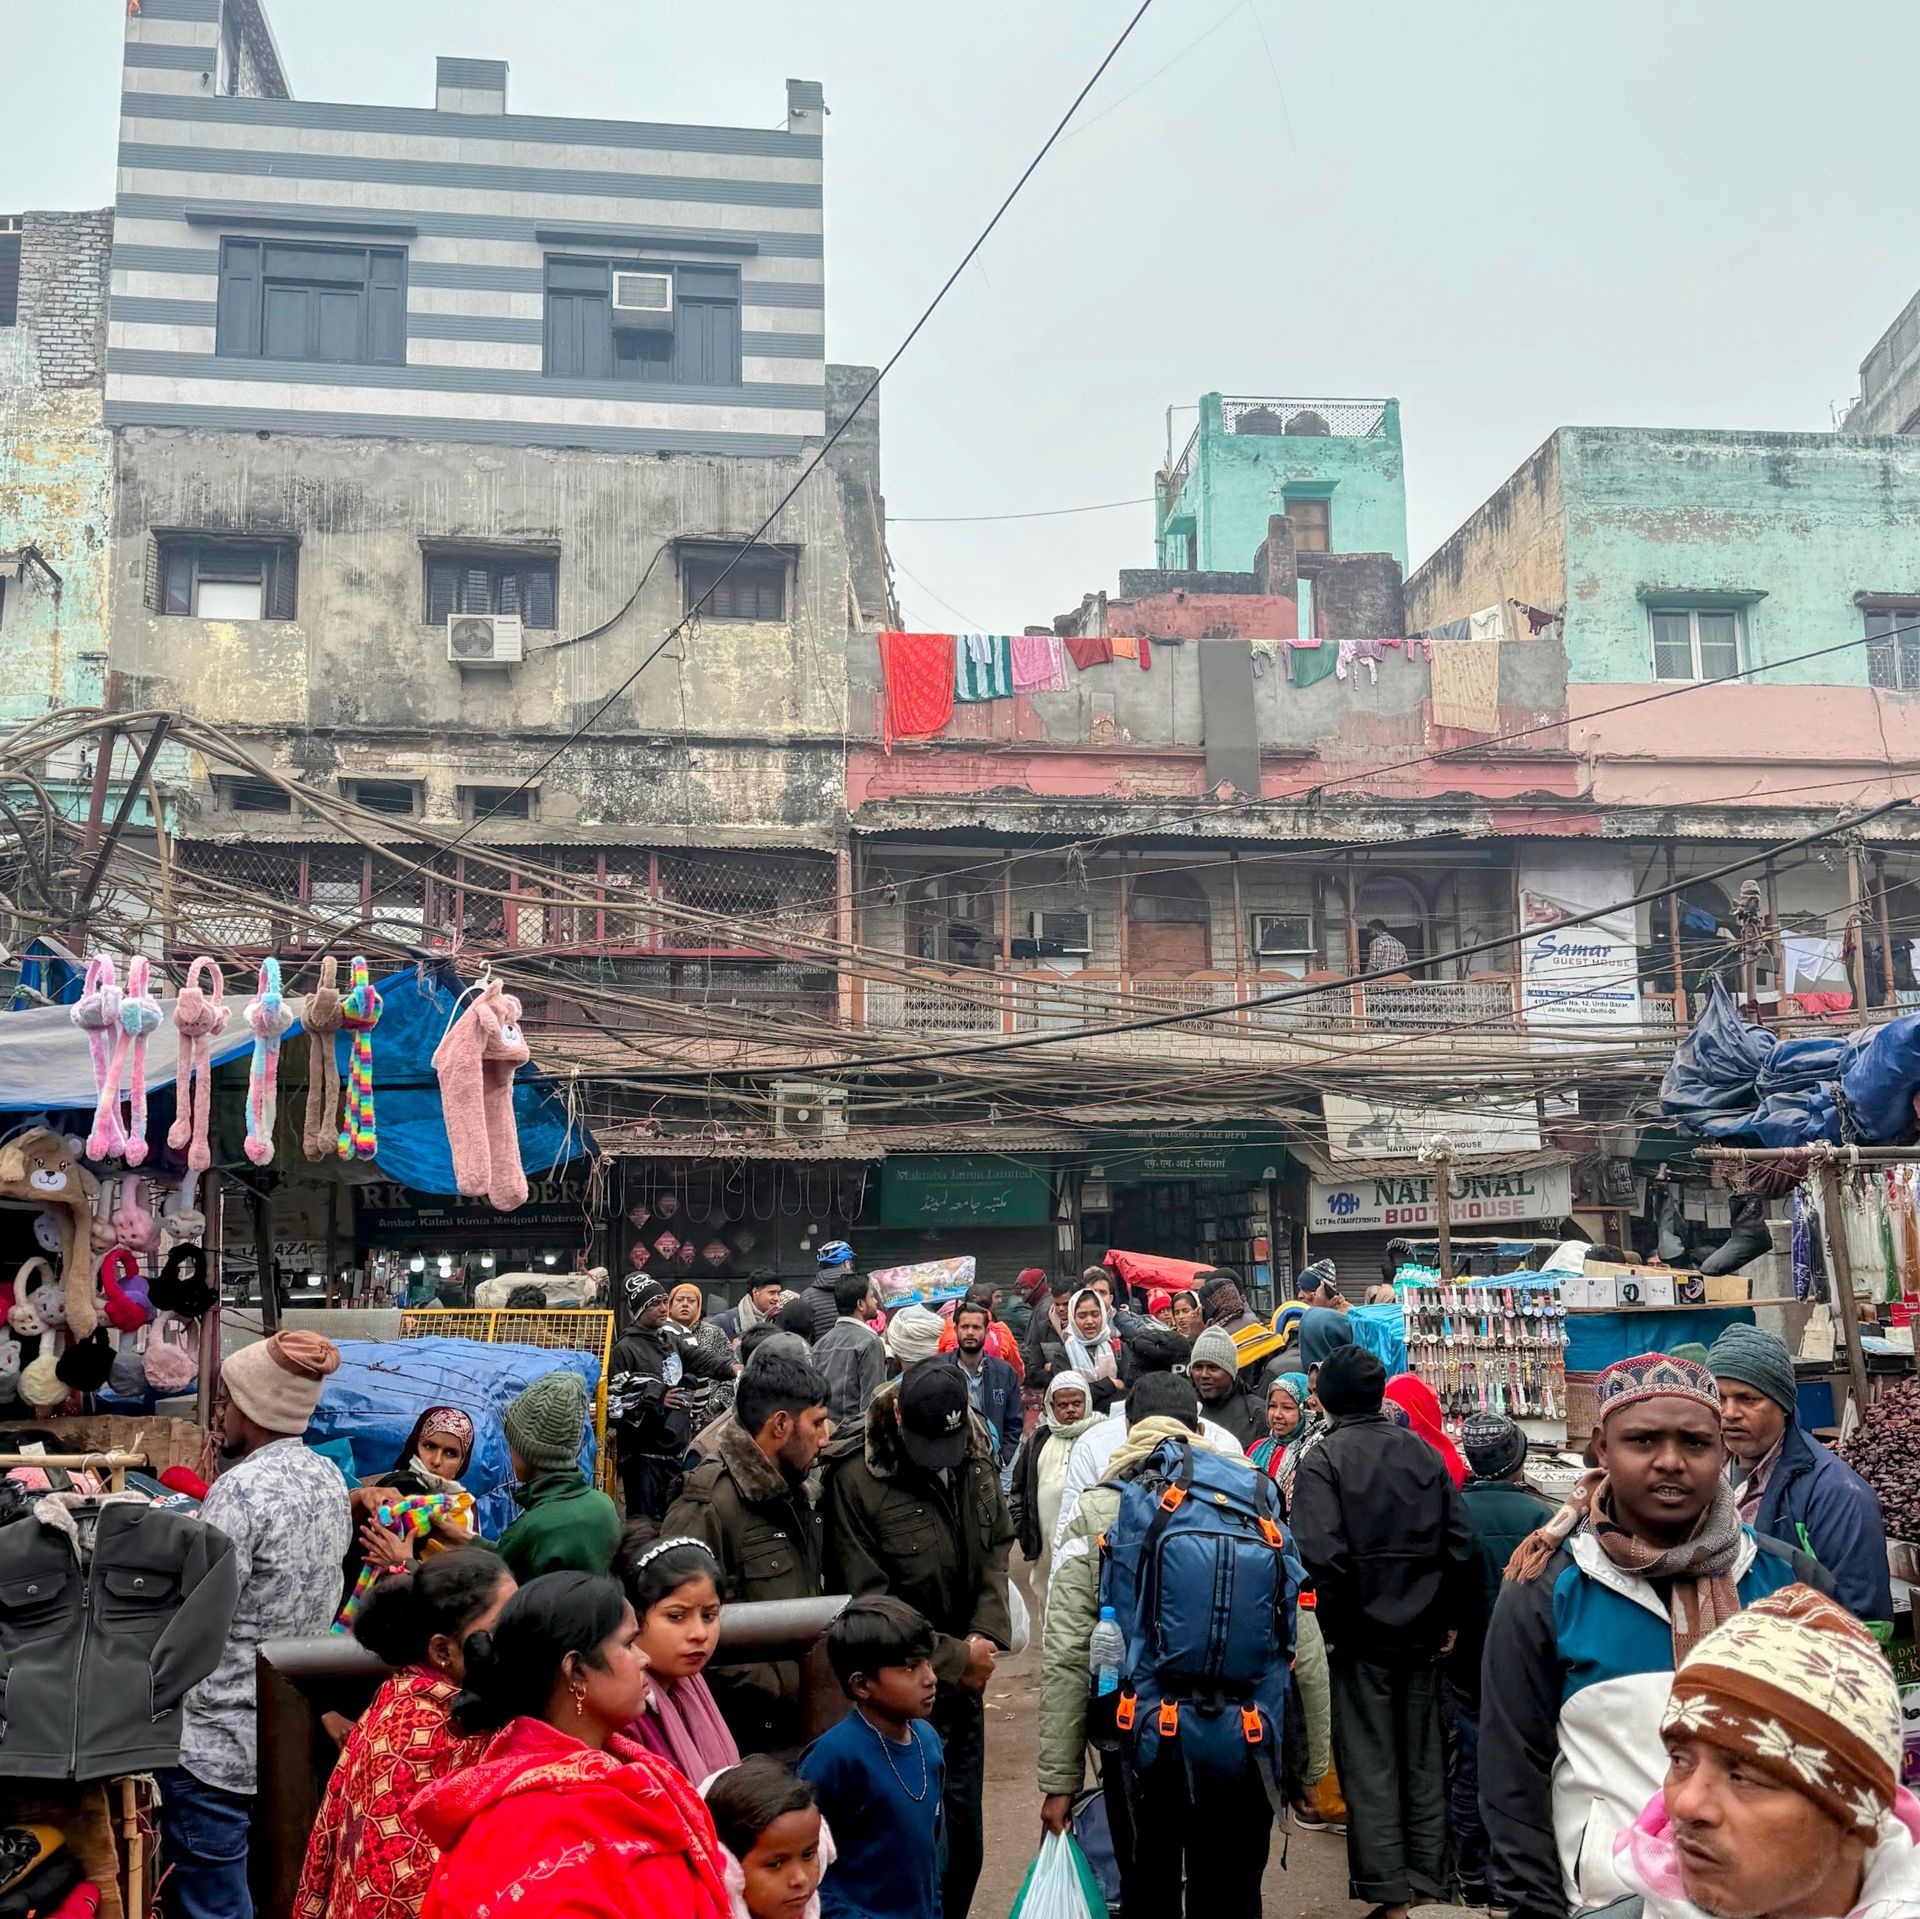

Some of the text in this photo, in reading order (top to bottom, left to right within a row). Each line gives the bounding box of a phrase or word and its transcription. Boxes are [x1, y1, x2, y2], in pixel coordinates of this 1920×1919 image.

[1531, 934, 1611, 961] Samar
[1553, 957, 1630, 967] GUEST HOUSE
[1202, 1131, 1222, 1140] SALE
[1454, 1141, 1483, 1150] HOUSE
[1374, 1171, 1535, 1207] NATONAL
[361, 1185, 411, 1210] RK
[1385, 1200, 1526, 1224] BOOT HOUSE
[378, 1213, 591, 1228] Amber Kalmi Kimia Medjoul Mabroo
[1315, 1218, 1327, 1226] GST
